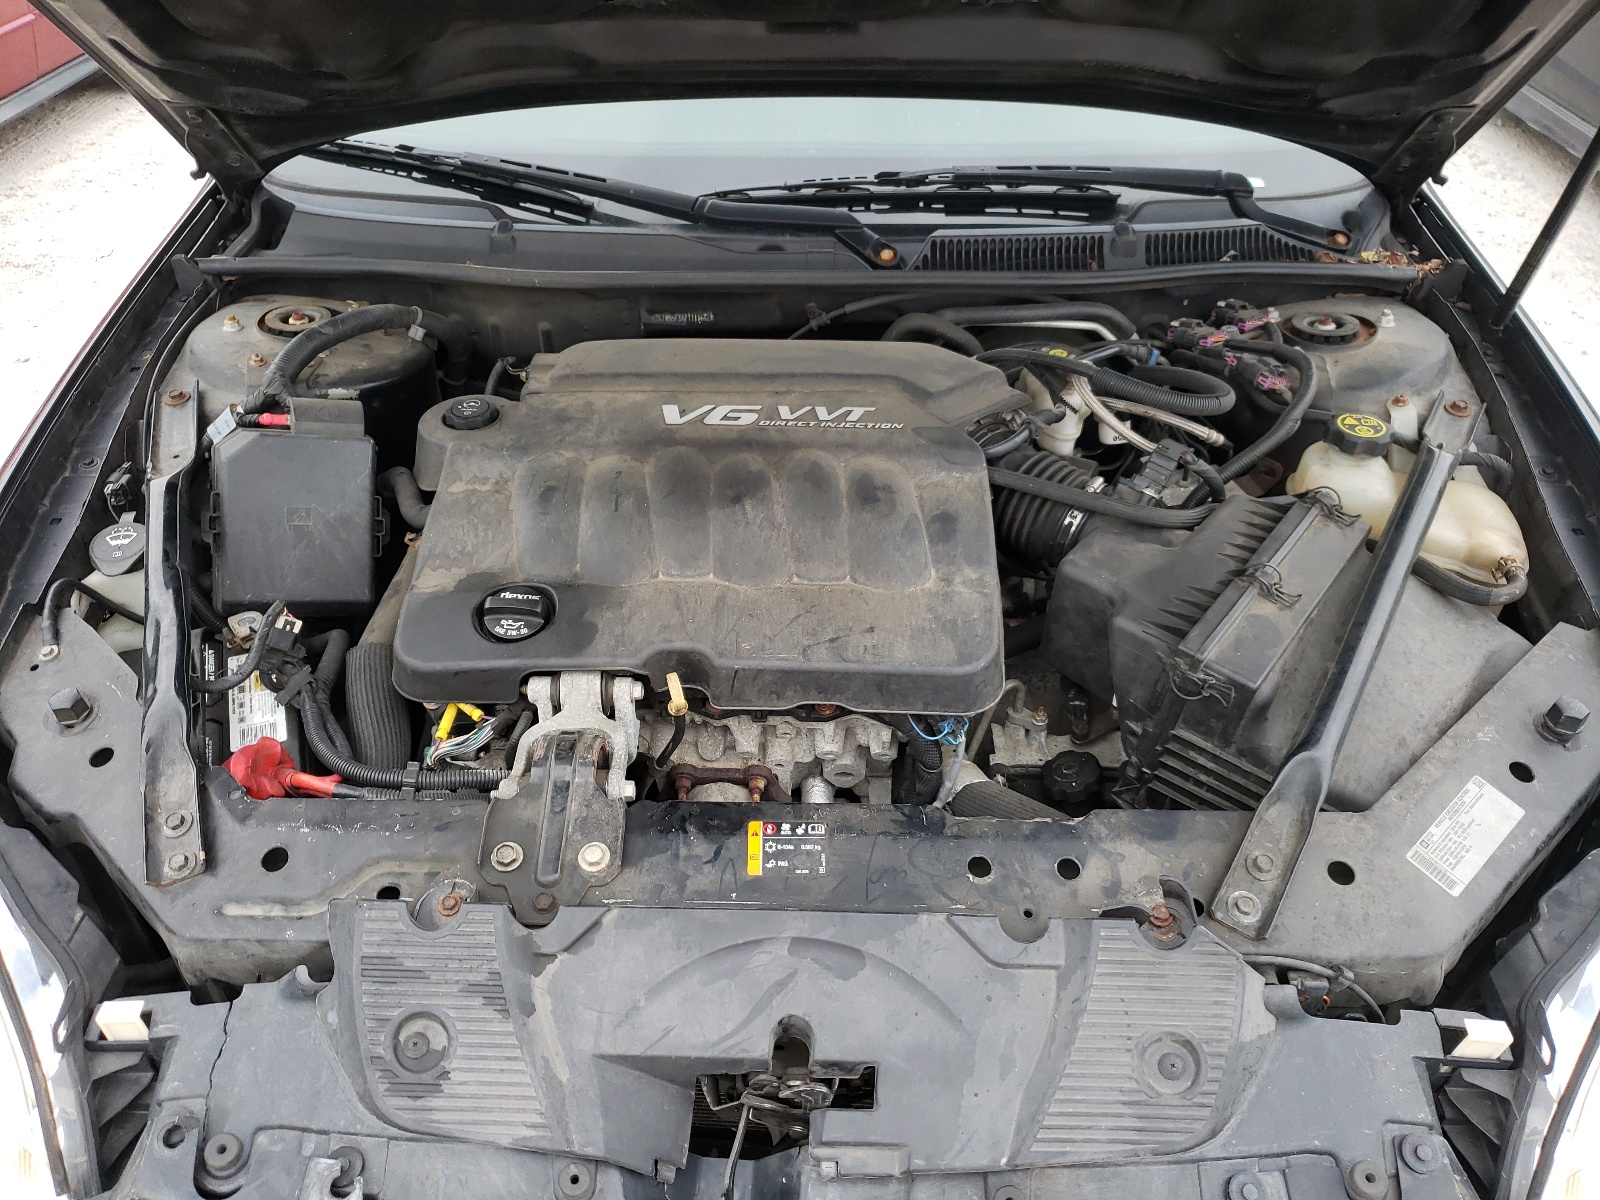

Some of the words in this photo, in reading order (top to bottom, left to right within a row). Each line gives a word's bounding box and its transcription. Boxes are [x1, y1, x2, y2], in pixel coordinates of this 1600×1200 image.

[662, 404, 762, 426] V6
[777, 405, 876, 421] VVT
[758, 420, 817, 428] DIRECT
[819, 421, 904, 429] INJECTION
